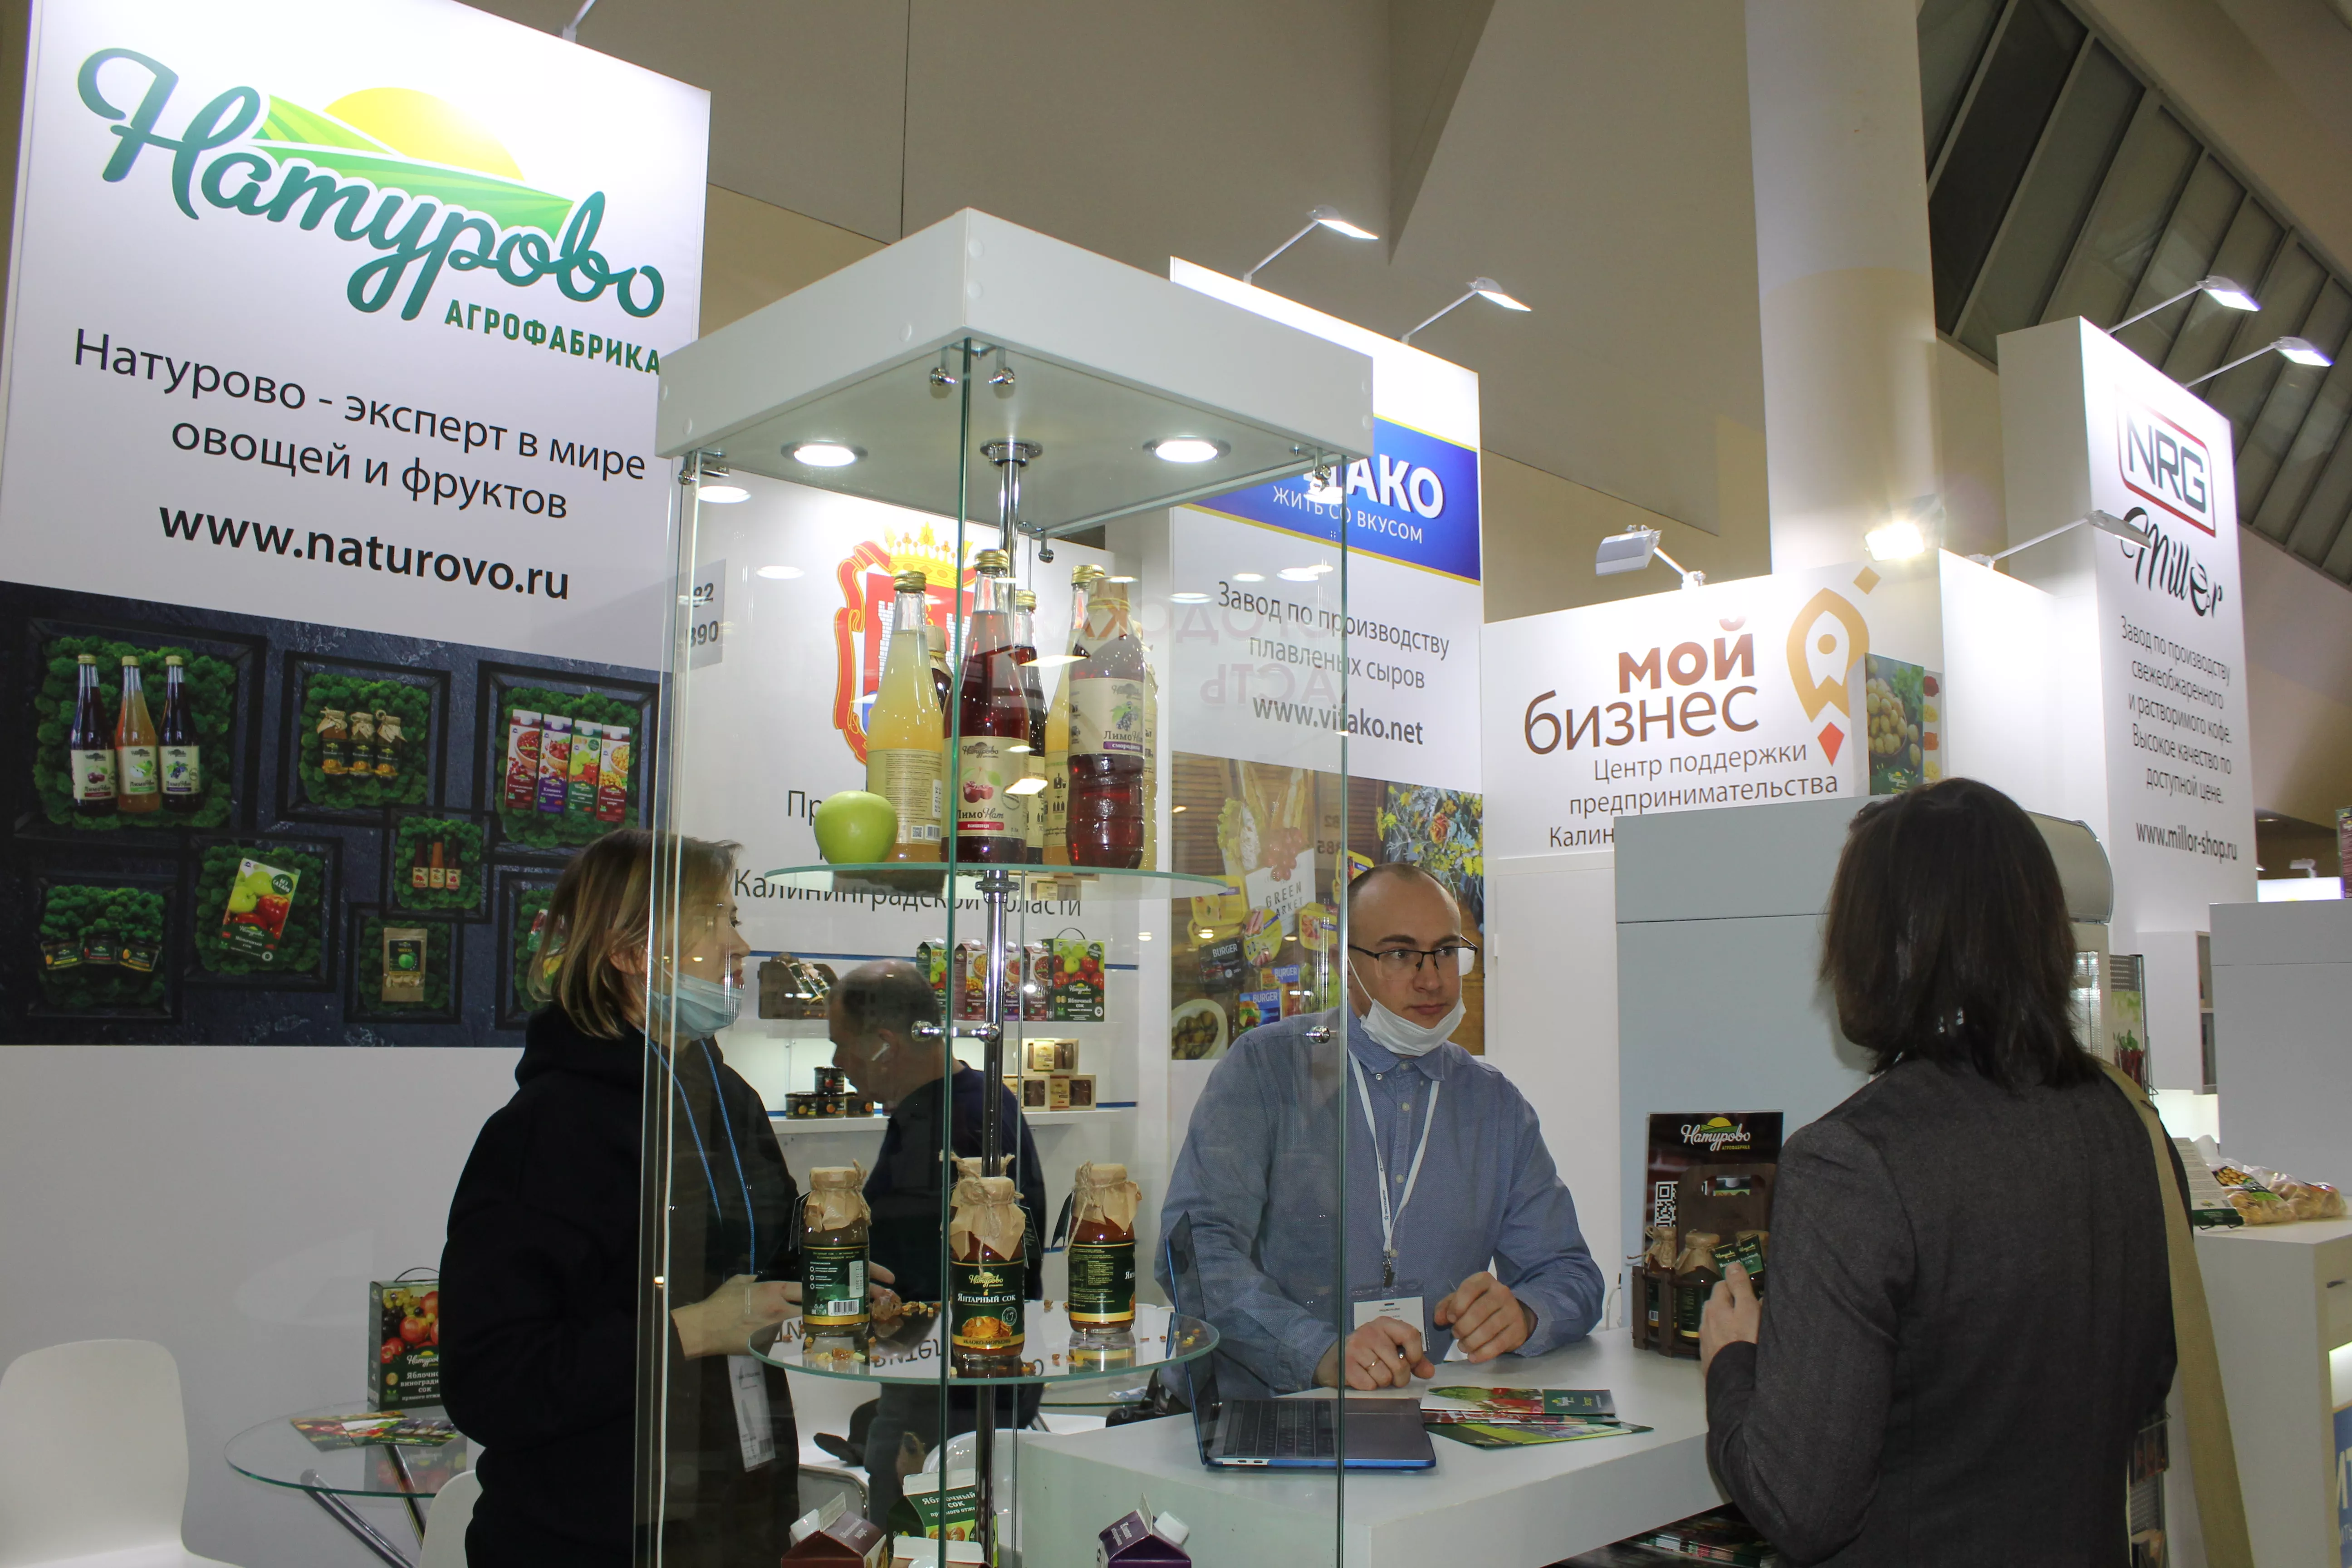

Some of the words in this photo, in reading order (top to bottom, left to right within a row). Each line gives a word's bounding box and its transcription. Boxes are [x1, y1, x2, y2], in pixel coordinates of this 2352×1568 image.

[77, 48, 664, 320] Натурово
[445, 299, 661, 376] АГРОФАБРИКА
[75, 328, 305, 410] Натурово
[344, 392, 507, 453] эксперт
[520, 432, 538, 457] в
[550, 438, 646, 482] мире
[172, 422, 350, 480] овощей
[365, 456, 388, 486] и
[402, 457, 568, 519] фруктов
[1329, 454, 1444, 519] АКО
[2127, 411, 2206, 514] NRG
[1273, 485, 1323, 515] ЖИТЬ
[1357, 510, 1422, 544] ВКУСОМ
[160, 506, 568, 600] www.naturovo.ru
[1218, 581, 1281, 623] Завод
[1287, 602, 1313, 625] по
[1319, 608, 1450, 660] производству
[1250, 636, 1361, 676] плавленых
[1367, 660, 1425, 690] сыров
[1619, 617, 1754, 693] мой
[2121, 615, 2152, 654] Завод
[2154, 636, 2166, 655] по
[2169, 642, 2230, 687] производству
[2132, 661, 2224, 709] свежеобжаренного
[1253, 696, 1423, 745] www.vitako.net
[1524, 685, 1758, 755] бизнес
[2129, 694, 2135, 711] и
[2138, 697, 2206, 735] растворимого
[2208, 719, 2232, 746] кофе.
[1595, 758, 1662, 784] Центр
[1670, 744, 1807, 773] поддержки
[2133, 723, 2176, 758] Высокое
[2178, 743, 2219, 771] качество
[2220, 757, 2231, 774] по
[1571, 775, 1838, 819] предпринимательства
[2147, 768, 2197, 797] доступной
[2200, 783, 2224, 804] цене.
[1550, 826, 1614, 848] Калин
[2136, 822, 2237, 863] www.millor-shop.ru
[1266, 881, 1302, 908] GREEN
[1275, 897, 1303, 916] ARKET
[1212, 943, 1238, 957] BURGER
[1274, 967, 1297, 976] BURGER
[1252, 991, 1278, 1003] BURGER
[1681, 1125, 1751, 1151] Натурово
[969, 1274, 1003, 1288] Натурово
[407, 1353, 439, 1367] Натуро
